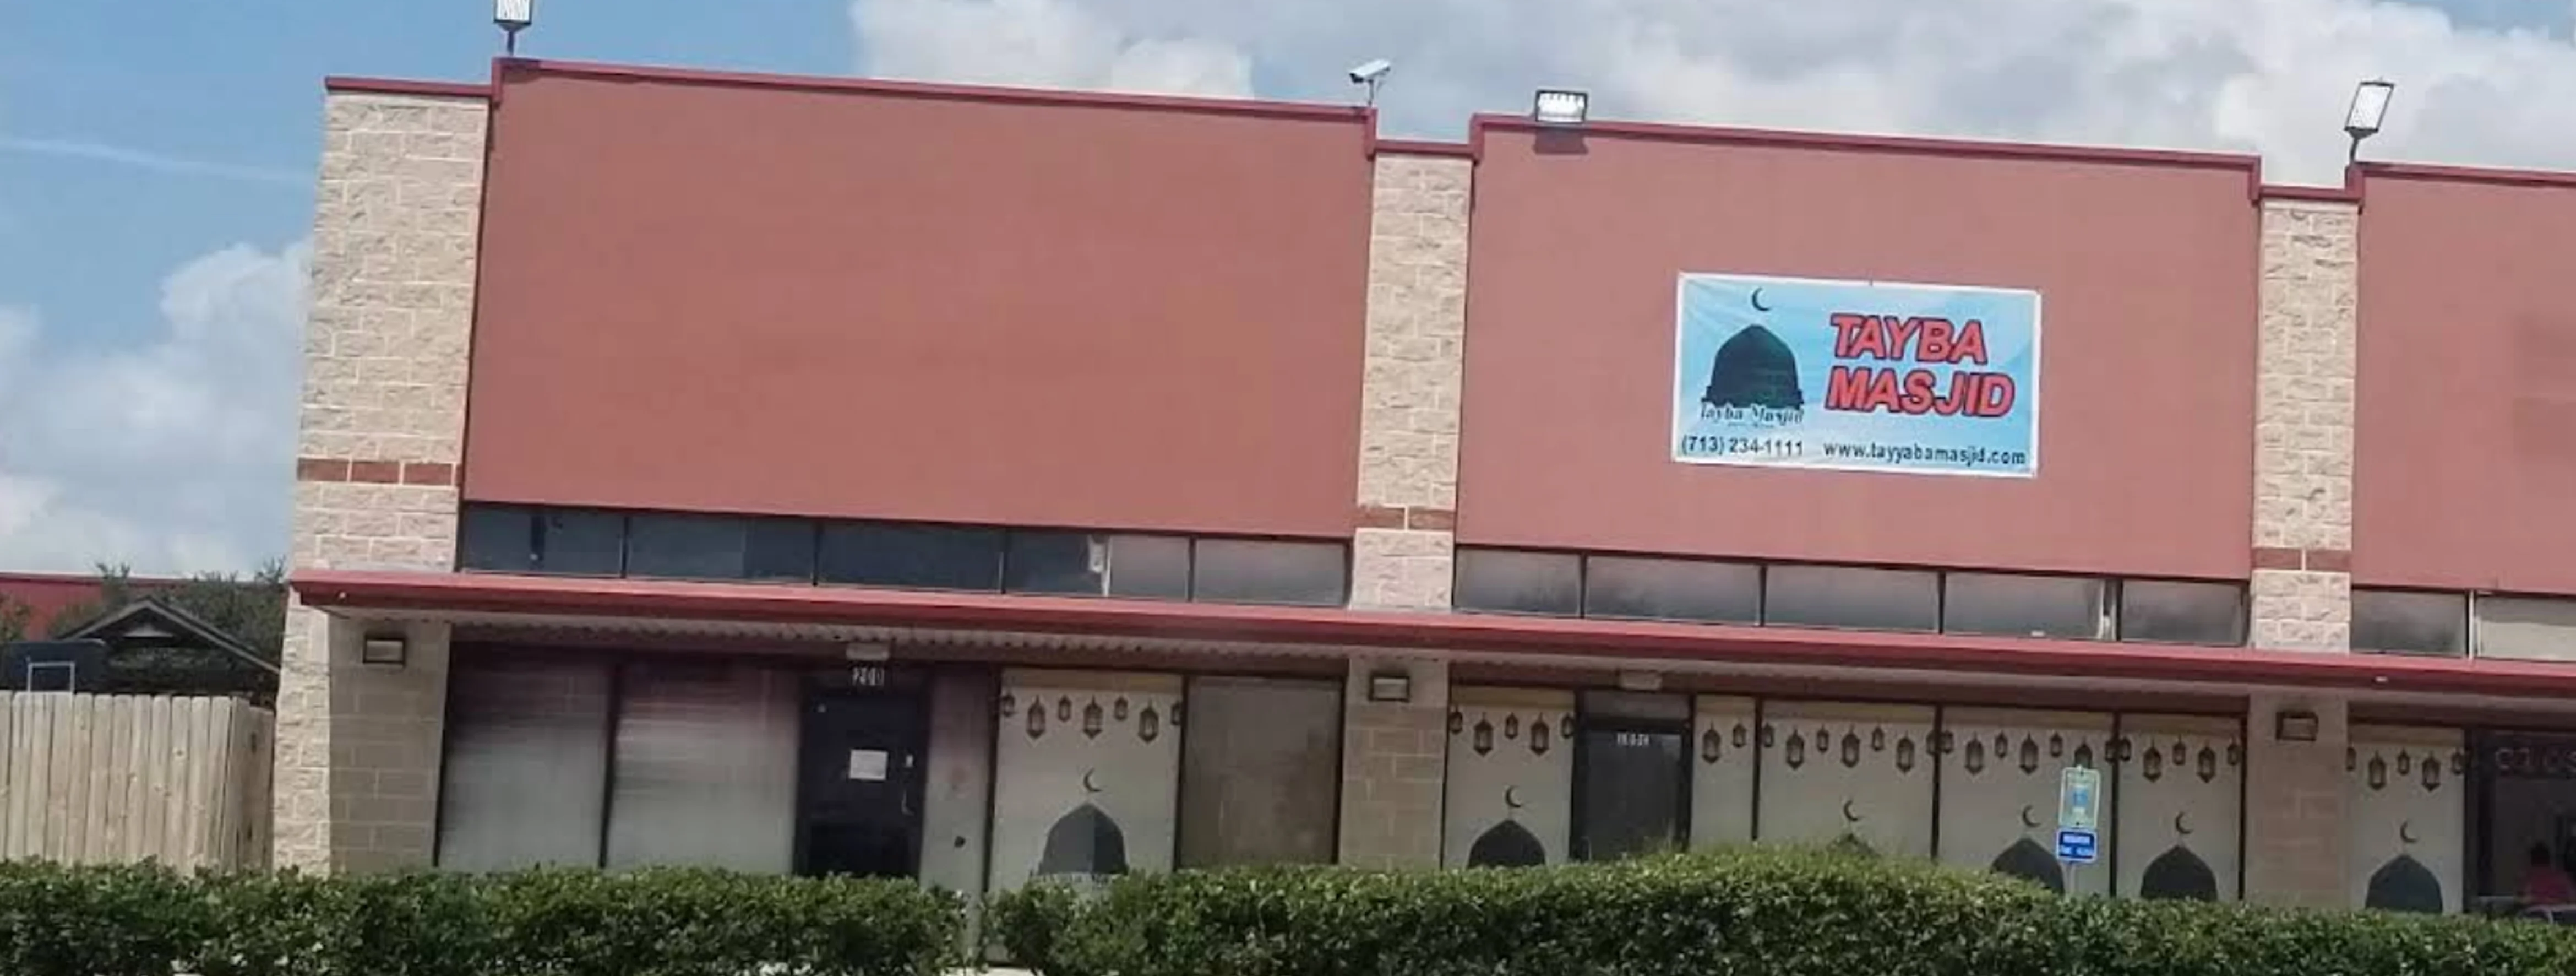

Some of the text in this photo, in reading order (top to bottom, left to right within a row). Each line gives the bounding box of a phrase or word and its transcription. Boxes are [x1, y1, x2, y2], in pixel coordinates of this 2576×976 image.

[1830, 313, 1987, 365] TAYBA
[1825, 366, 2015, 417] MASJID
[1682, 435, 1803, 456] (713) 234-1111
[1823, 442, 2025, 467] www.tayyabamasjid.com
